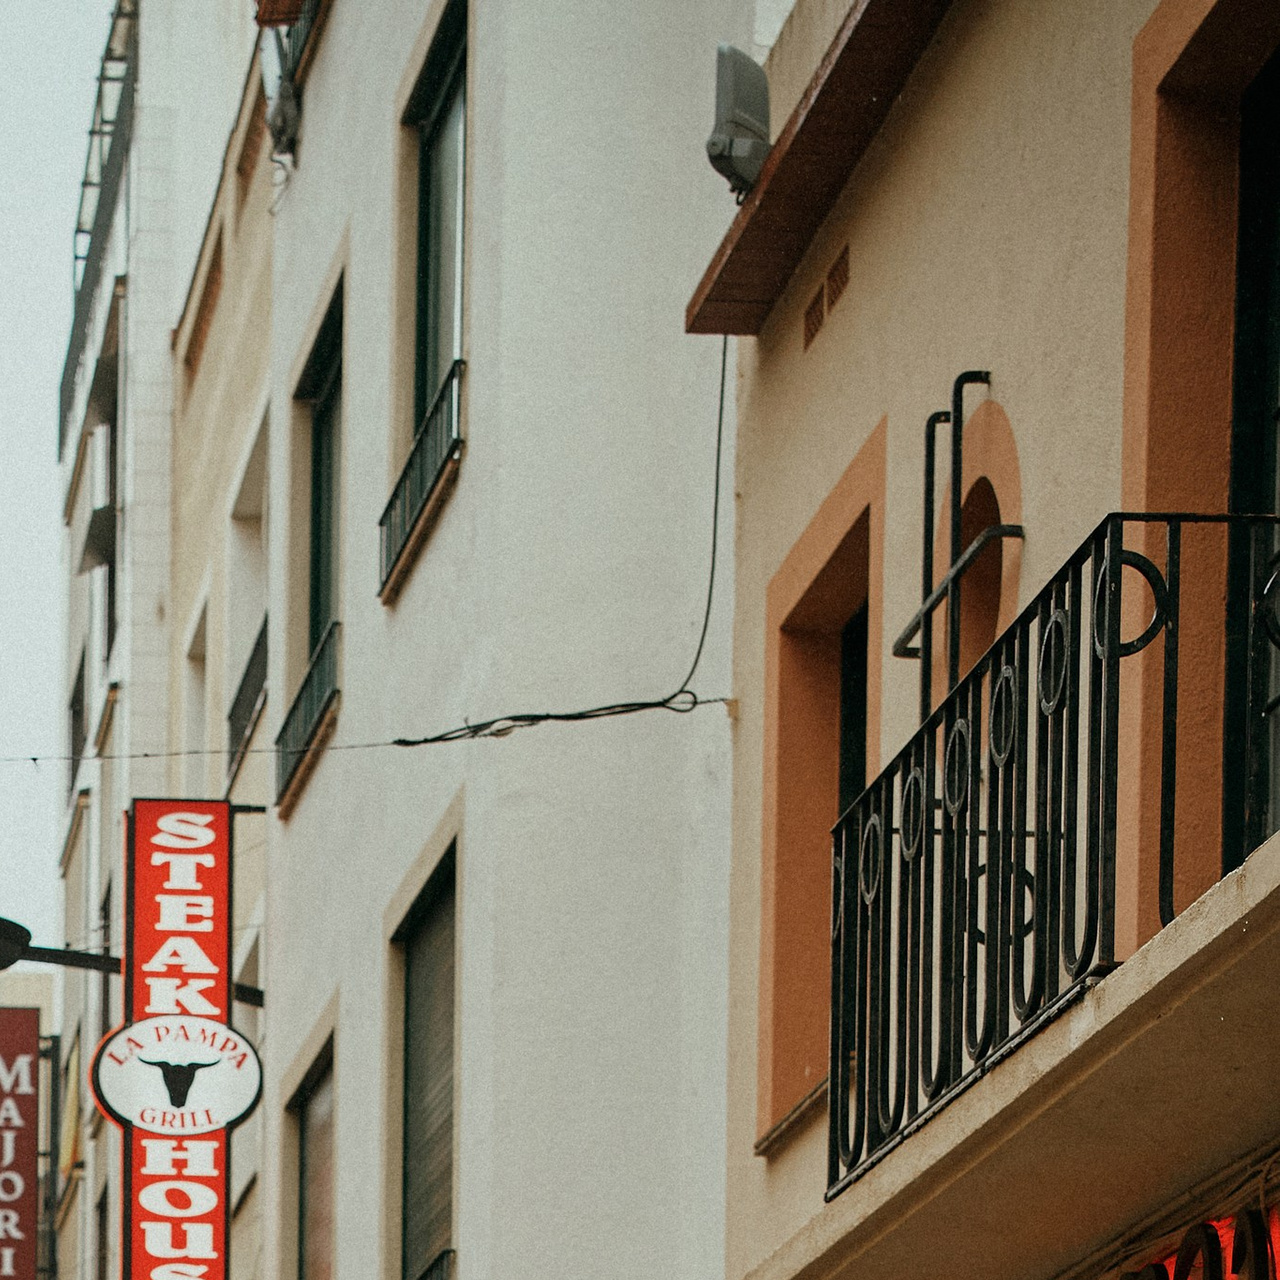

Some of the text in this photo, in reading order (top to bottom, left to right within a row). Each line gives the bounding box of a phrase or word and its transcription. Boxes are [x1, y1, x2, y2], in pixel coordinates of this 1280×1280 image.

[144, 811, 222, 1015] STEAK
[107, 1024, 248, 1070] LA PAMPA
[140, 1108, 219, 1128] GRILL
